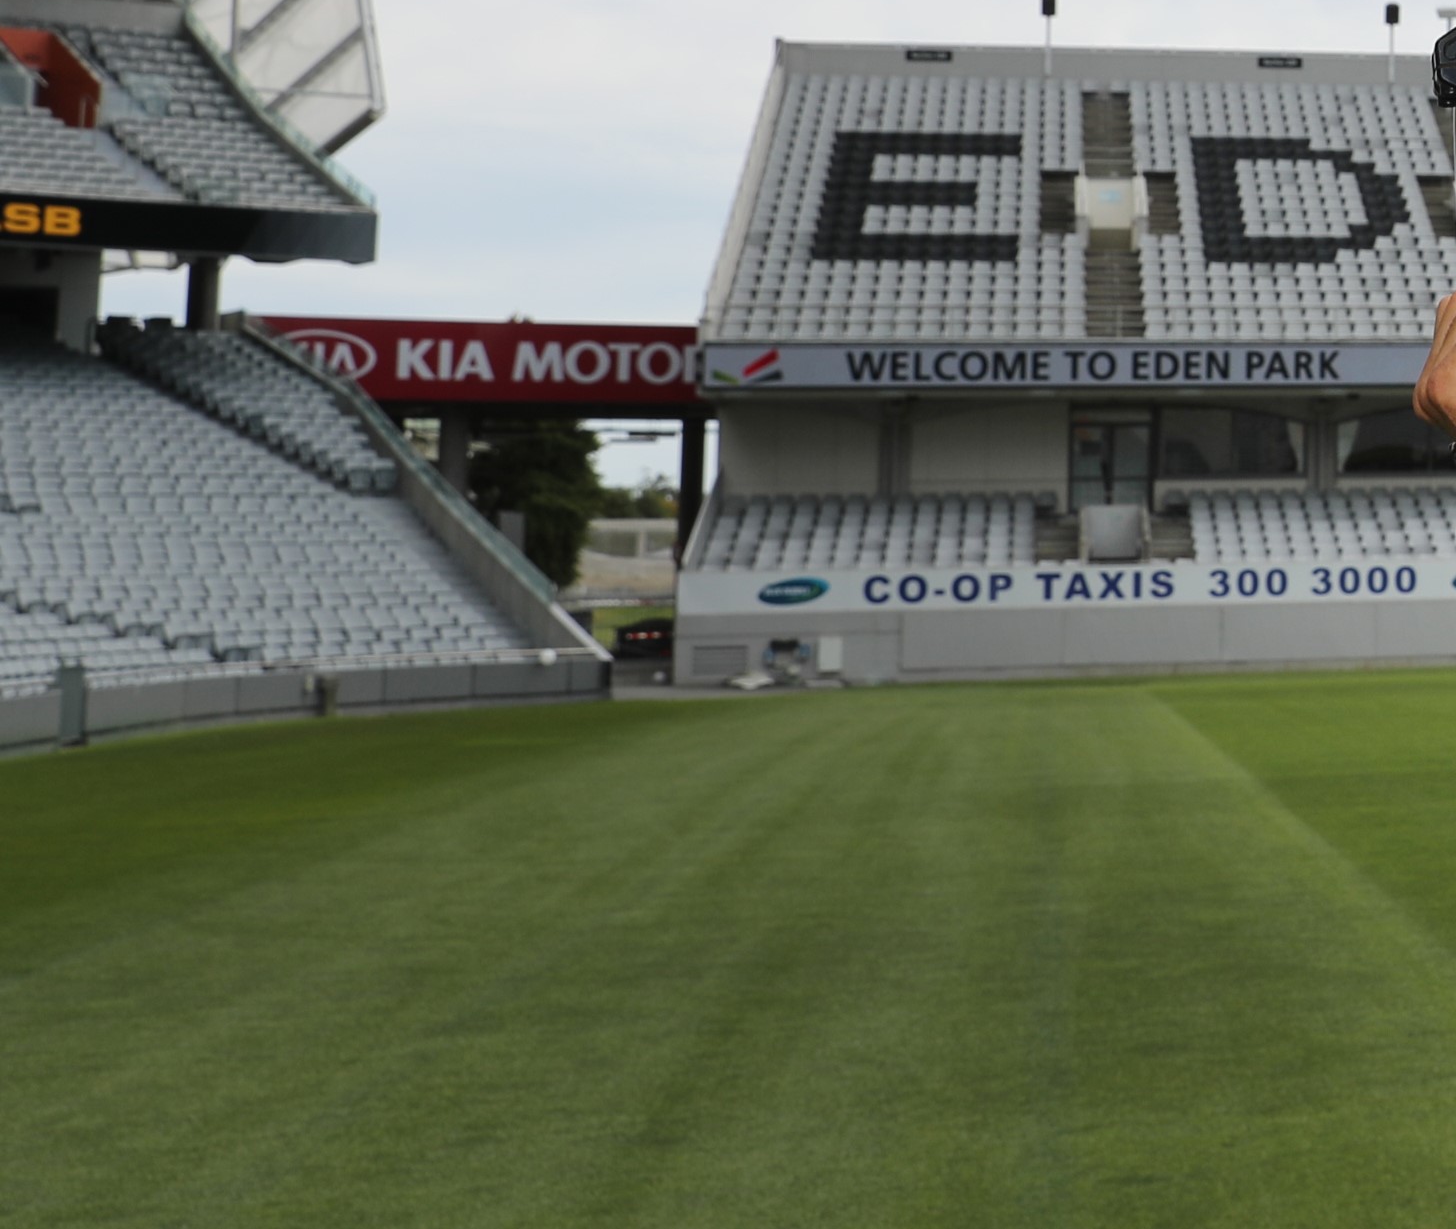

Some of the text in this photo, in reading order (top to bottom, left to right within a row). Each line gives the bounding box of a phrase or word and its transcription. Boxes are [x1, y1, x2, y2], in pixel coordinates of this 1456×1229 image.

[0, 202, 82, 237] SB
[396, 339, 495, 382] KIA
[846, 349, 1341, 383] WELCOME TO EDEN PARK
[863, 565, 1418, 605] CO-OP TAXIS 300 3000
